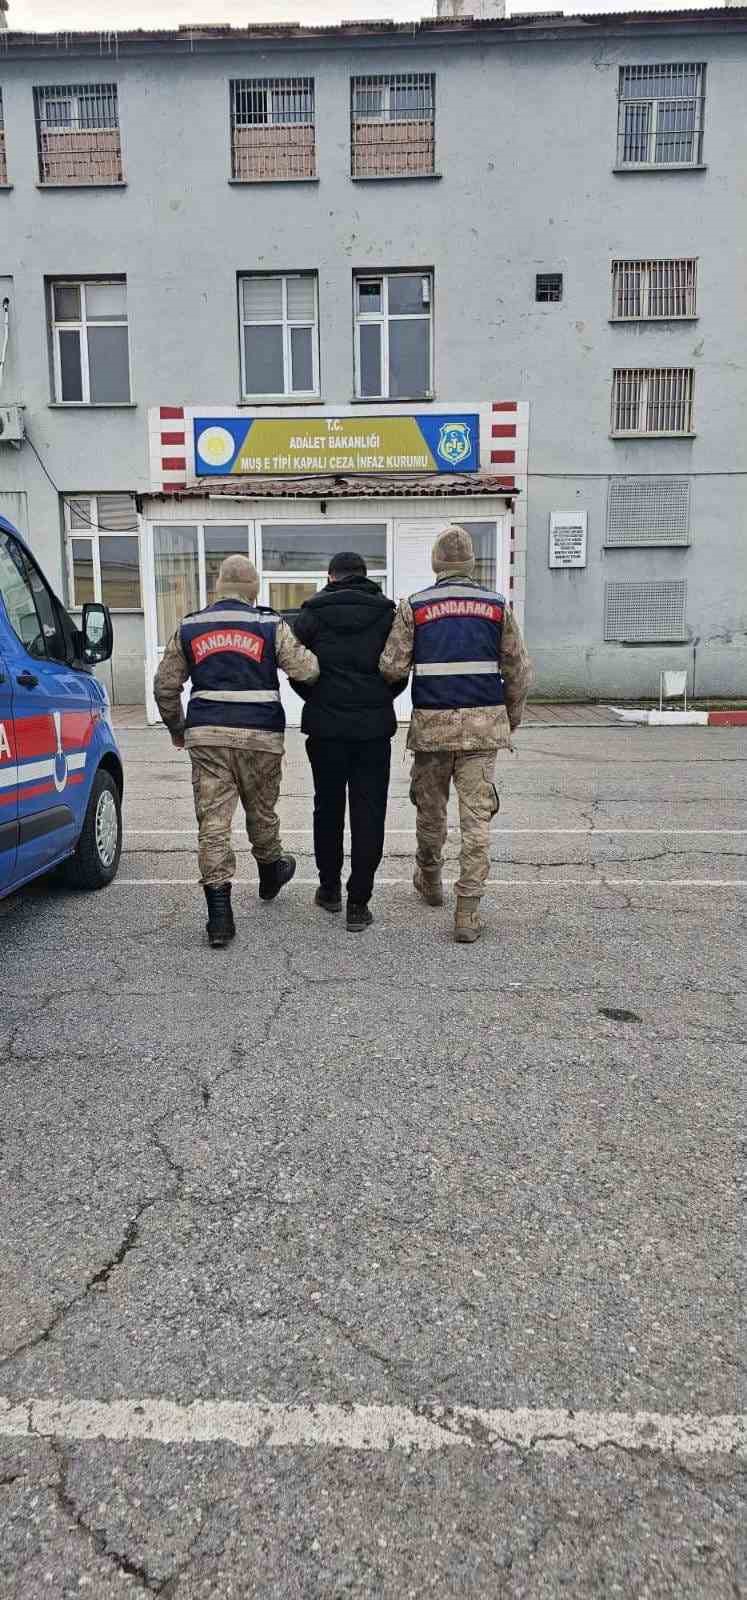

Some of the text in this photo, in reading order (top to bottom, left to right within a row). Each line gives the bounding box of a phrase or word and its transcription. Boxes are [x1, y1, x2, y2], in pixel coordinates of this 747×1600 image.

[327, 419, 344, 431] T.C.
[290, 434, 380, 449] ADALET BAKANLIĞI
[241, 454, 429, 471] MUŞ E TİPİ KAPALI CEZA İNFAZ KURUMU
[425, 600, 494, 619] JANDARMA
[195, 631, 260, 655] JANDARMA
